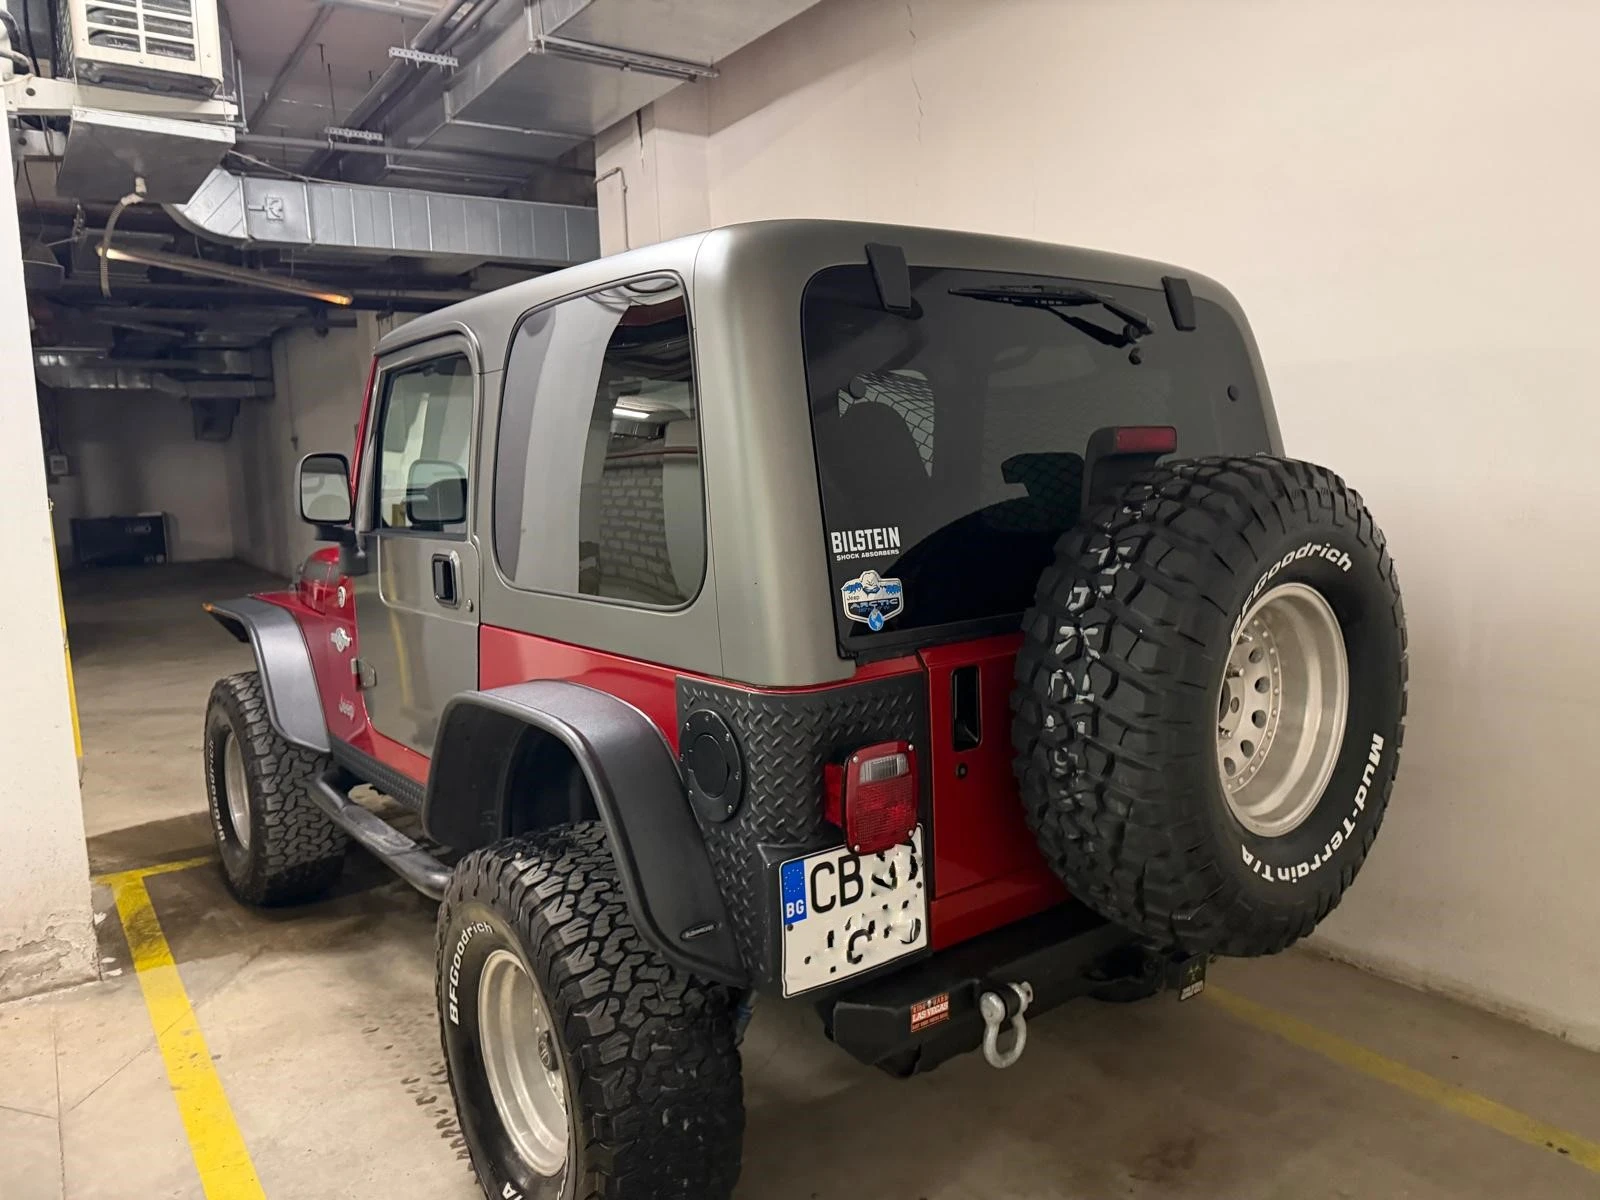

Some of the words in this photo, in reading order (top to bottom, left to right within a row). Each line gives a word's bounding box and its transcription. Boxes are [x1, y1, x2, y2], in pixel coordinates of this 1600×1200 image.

[831, 527, 900, 553] BILSTEIN
[836, 552, 860, 561] SHOCK
[861, 549, 900, 558] ABSORBERS
[1277, 733, 1384, 883] Mud-Terrain
[786, 899, 805, 919] BG
[449, 921, 494, 1025] BFGoodrich
